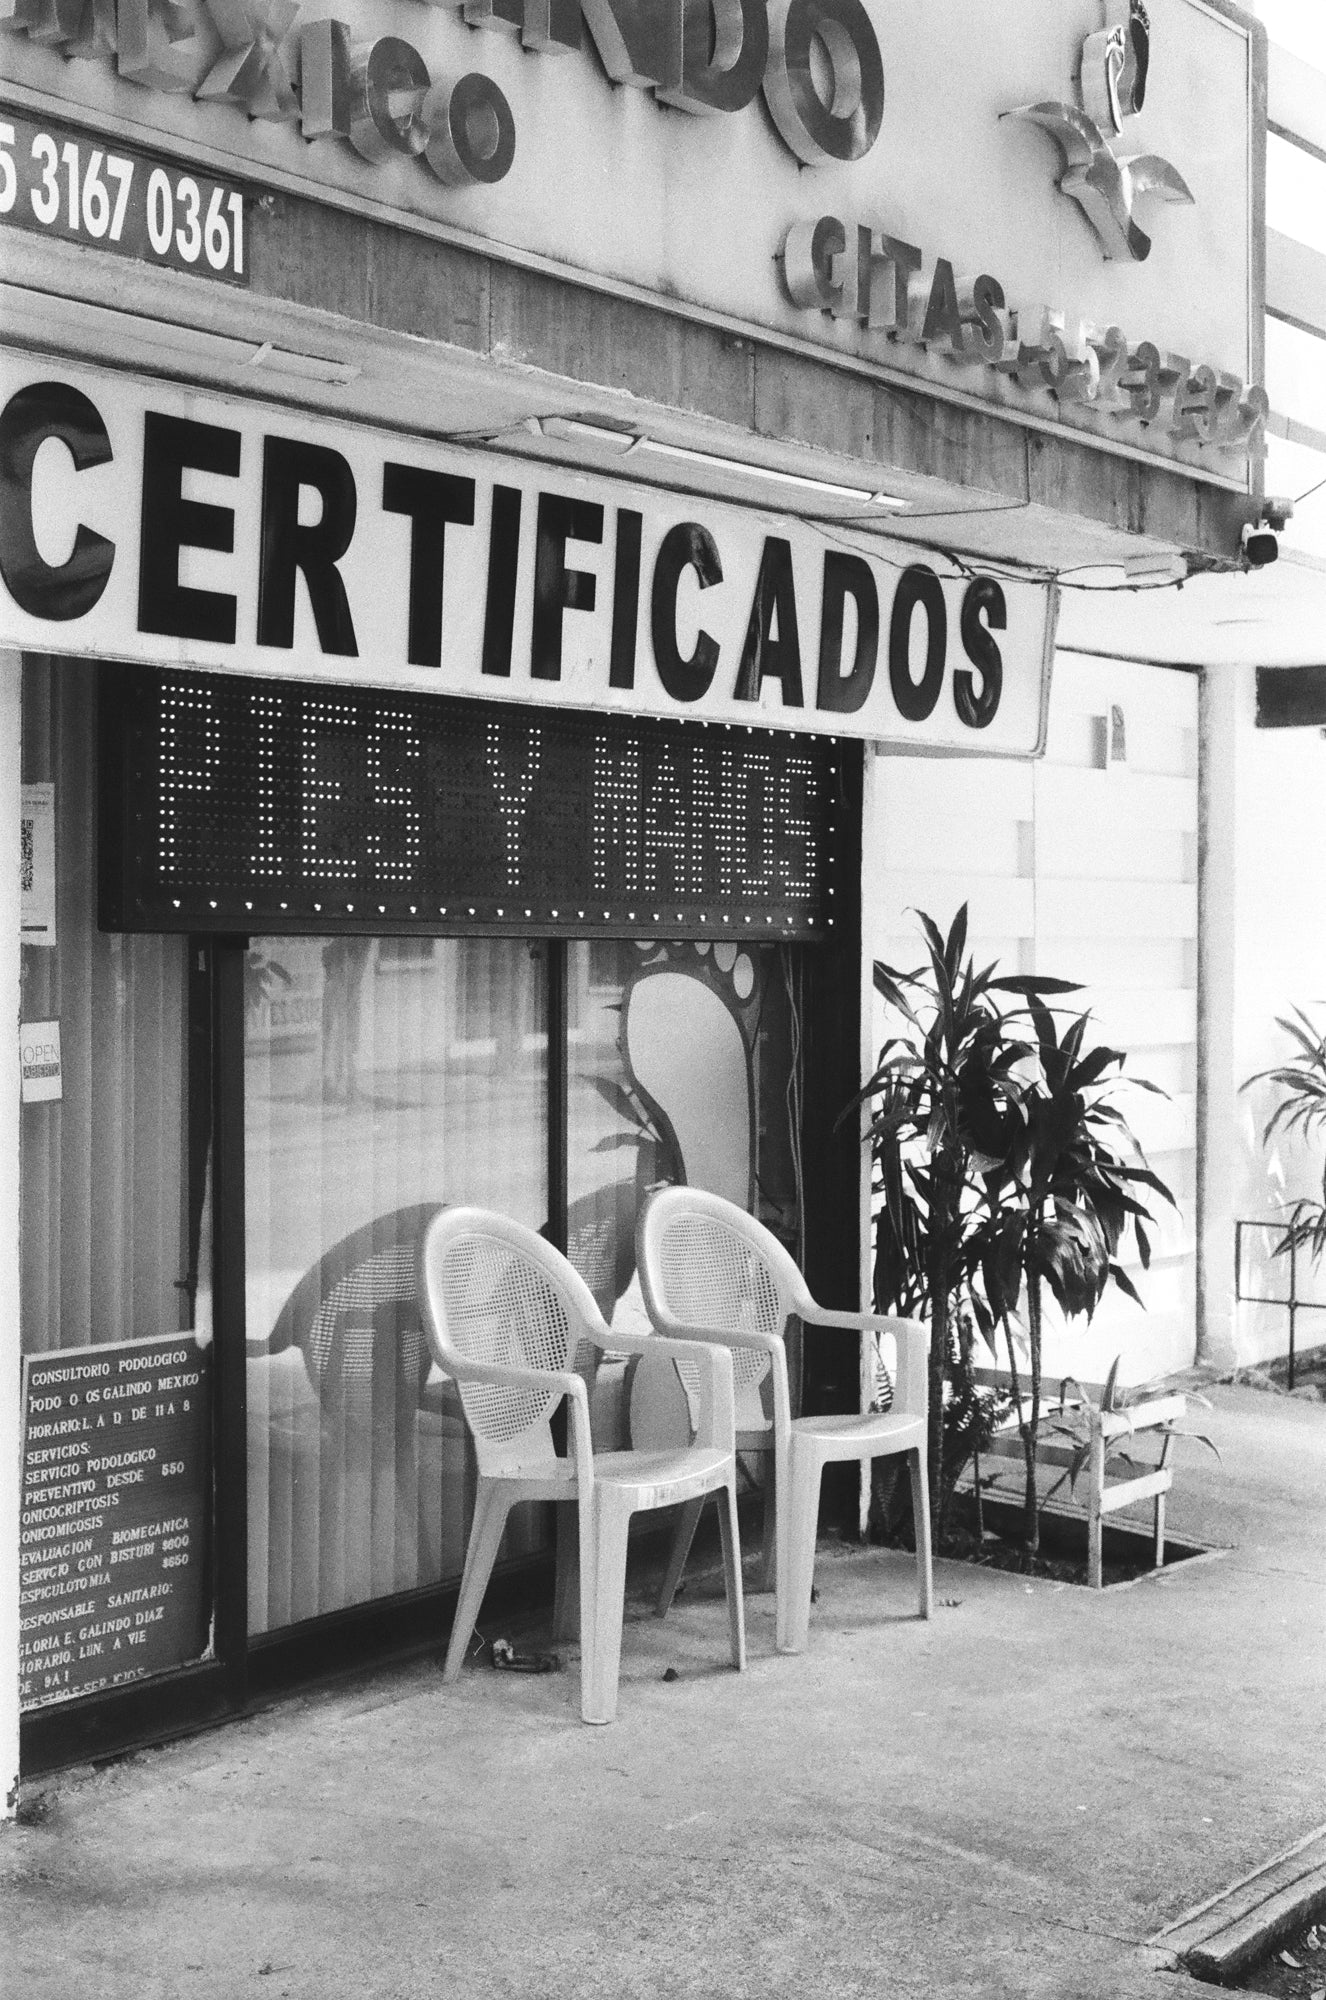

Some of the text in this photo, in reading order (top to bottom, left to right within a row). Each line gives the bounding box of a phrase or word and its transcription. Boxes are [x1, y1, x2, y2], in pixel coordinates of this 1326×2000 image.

[30, 132, 135, 242] 3167
[146, 167, 244, 274] 0361
[785, 215, 1006, 367] CITAS
[0, 380, 1007, 729] CERTIFICADOS
[158, 685, 817, 898] PIES Y MANOS
[31, 1350, 187, 1386] CONSULTORIO PODOLOGICO
[103, 1381, 152, 1400] GALINDO
[96, 1413, 105, 1428] A
[131, 1406, 147, 1421] DE
[183, 1399, 190, 1412] 8
[25, 1448, 156, 1485] SERVICIO PODOLOGICO
[25, 1480, 96, 1505] PREVENTIVO
[107, 1470, 144, 1488] DESDE
[22, 1493, 119, 1525] ONICOCRIPTOSIS
[21, 1517, 189, 1566] EVALUACION BIOMECANICA
[22, 1515, 103, 1544] ONICOMICOSIS
[78, 1554, 103, 1572] CON
[110, 1542, 155, 1564] BISTURI
[107, 1583, 173, 1608] SANITARIO:
[79, 1617, 130, 1640] GALINDO
[135, 1606, 164, 1626] DIAZ
[113, 1637, 121, 1650] A
[128, 1630, 146, 1645] VIE
